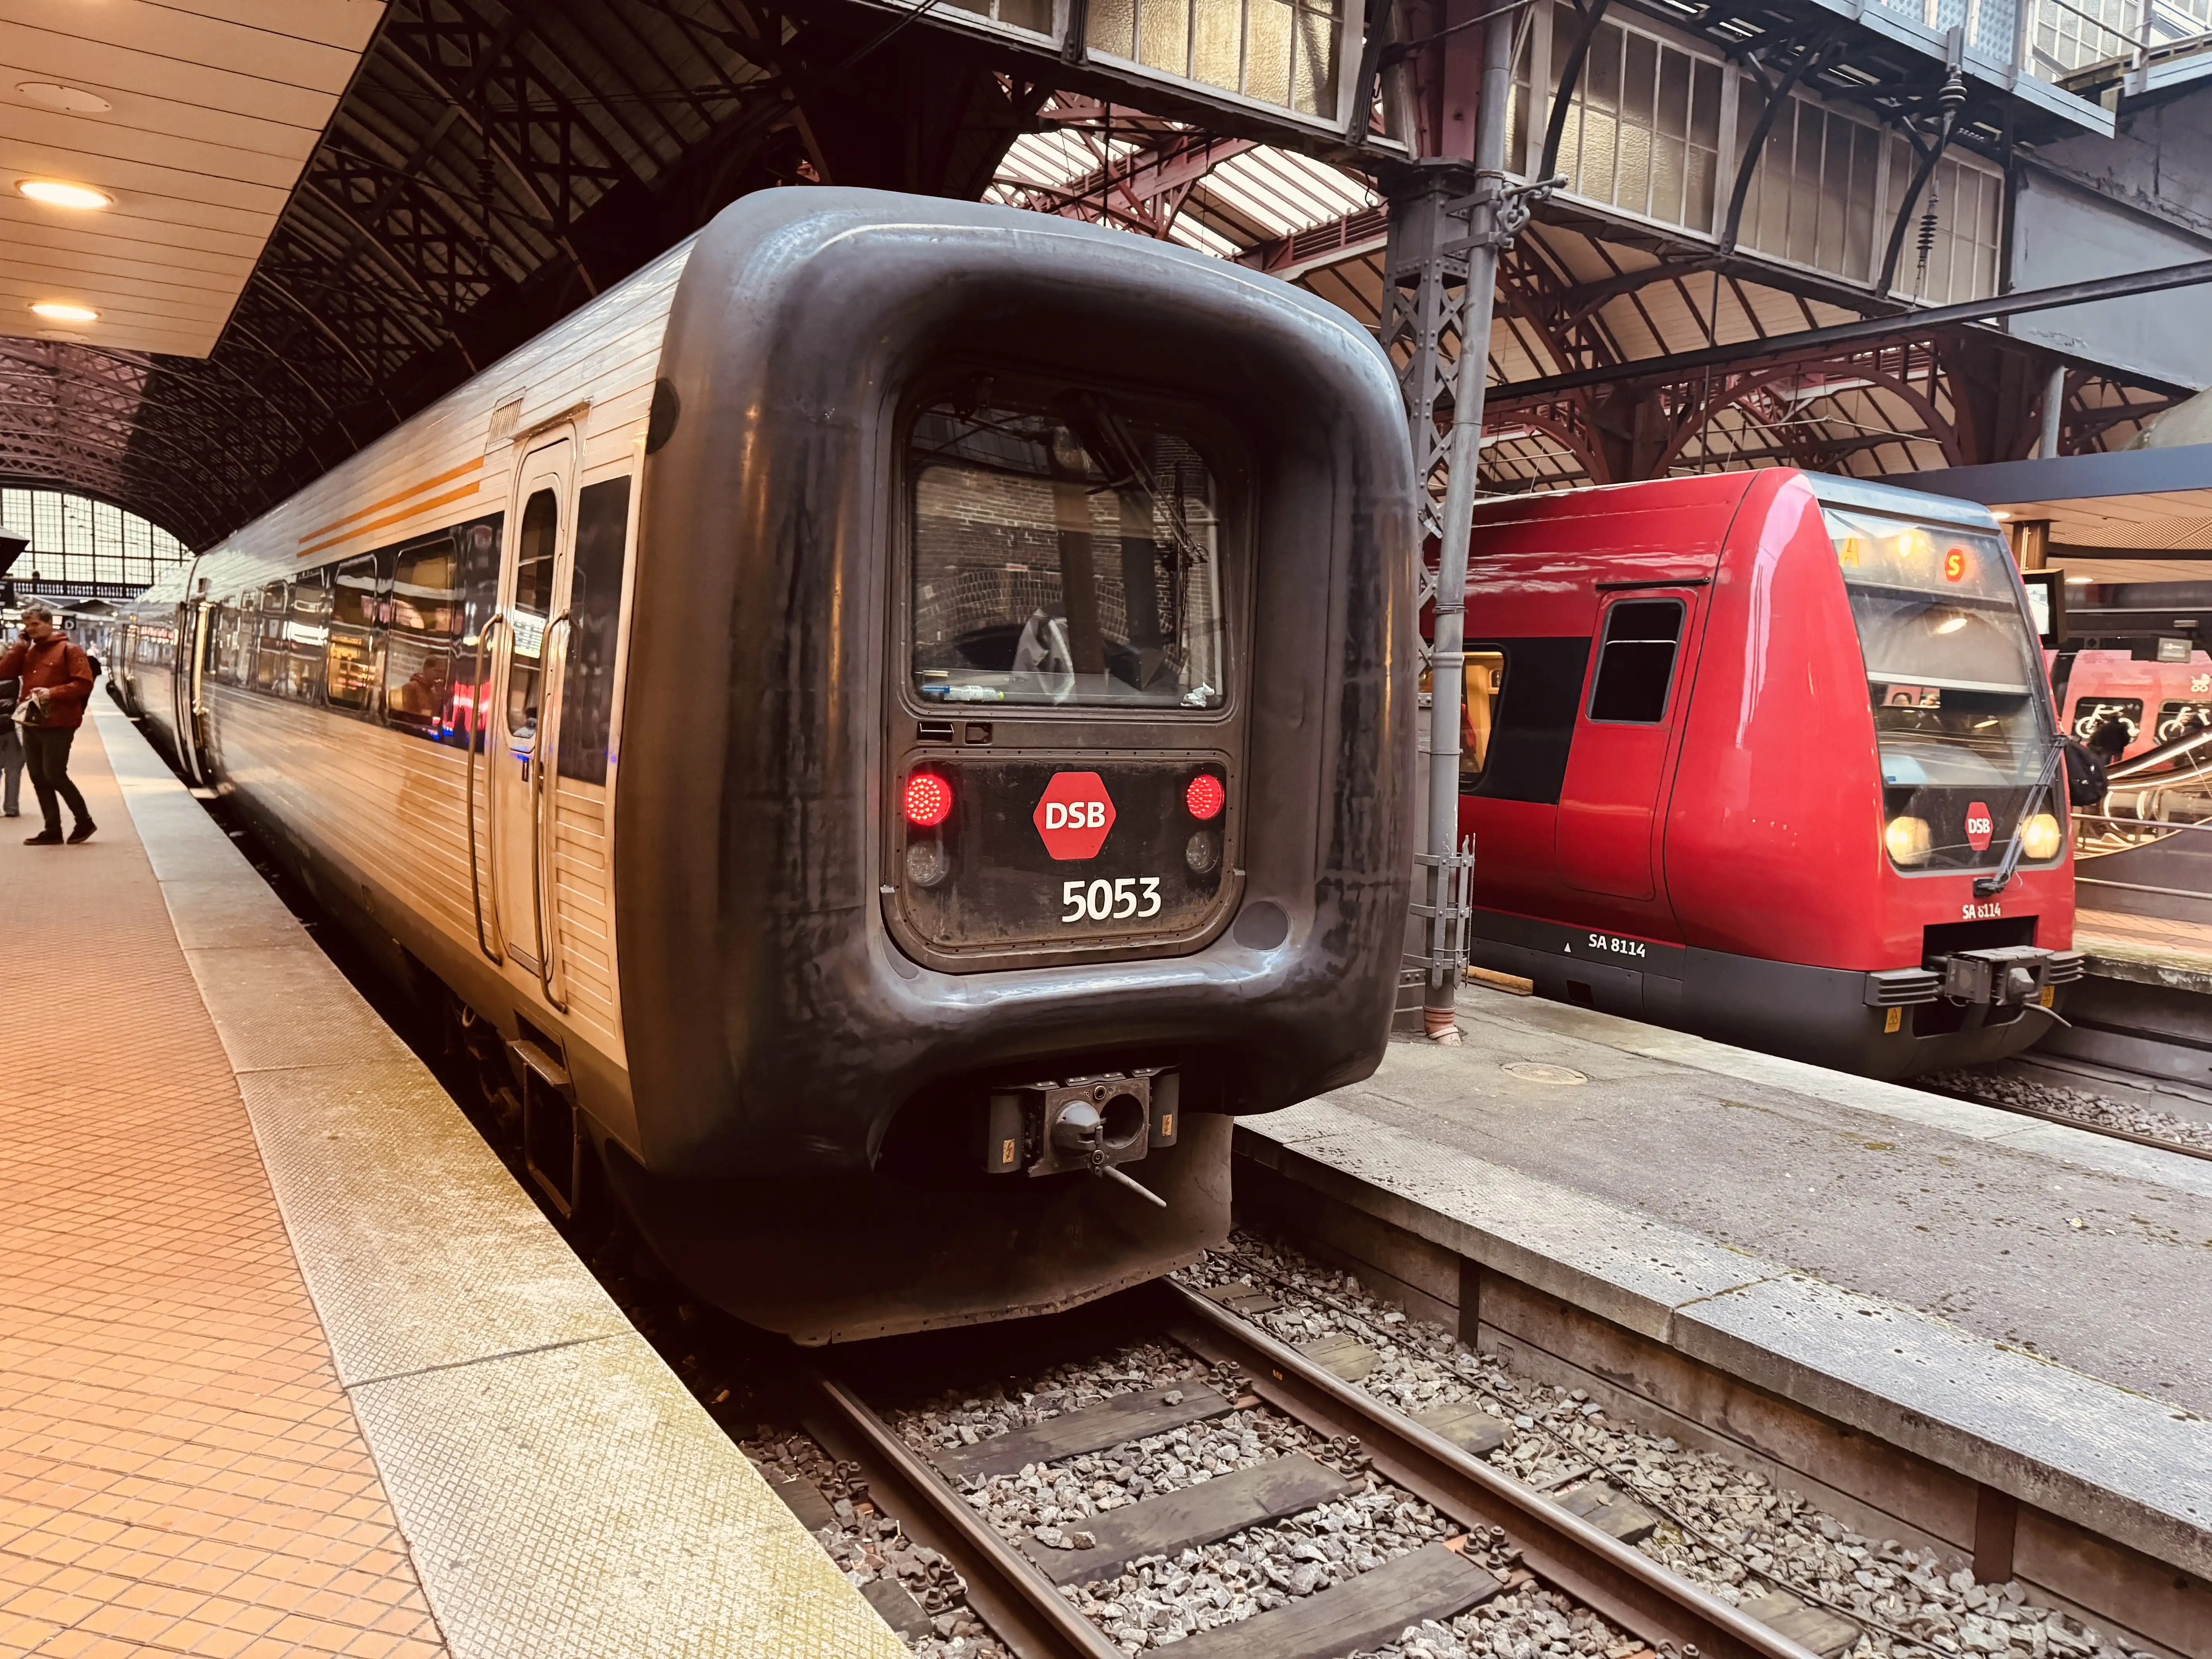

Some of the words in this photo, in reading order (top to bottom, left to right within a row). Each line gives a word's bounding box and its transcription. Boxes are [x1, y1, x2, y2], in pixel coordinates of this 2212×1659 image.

[1839, 536, 1858, 568] A
[1948, 555, 1960, 575] S
[1046, 802, 1106, 830] DSB
[1968, 818, 1990, 834] DSB
[1062, 877, 1161, 922] 5053
[1962, 904, 1976, 919] SA
[1977, 902, 2001, 918] 8114
[1589, 934, 1607, 950] SA
[1611, 938, 1645, 958] 8114
